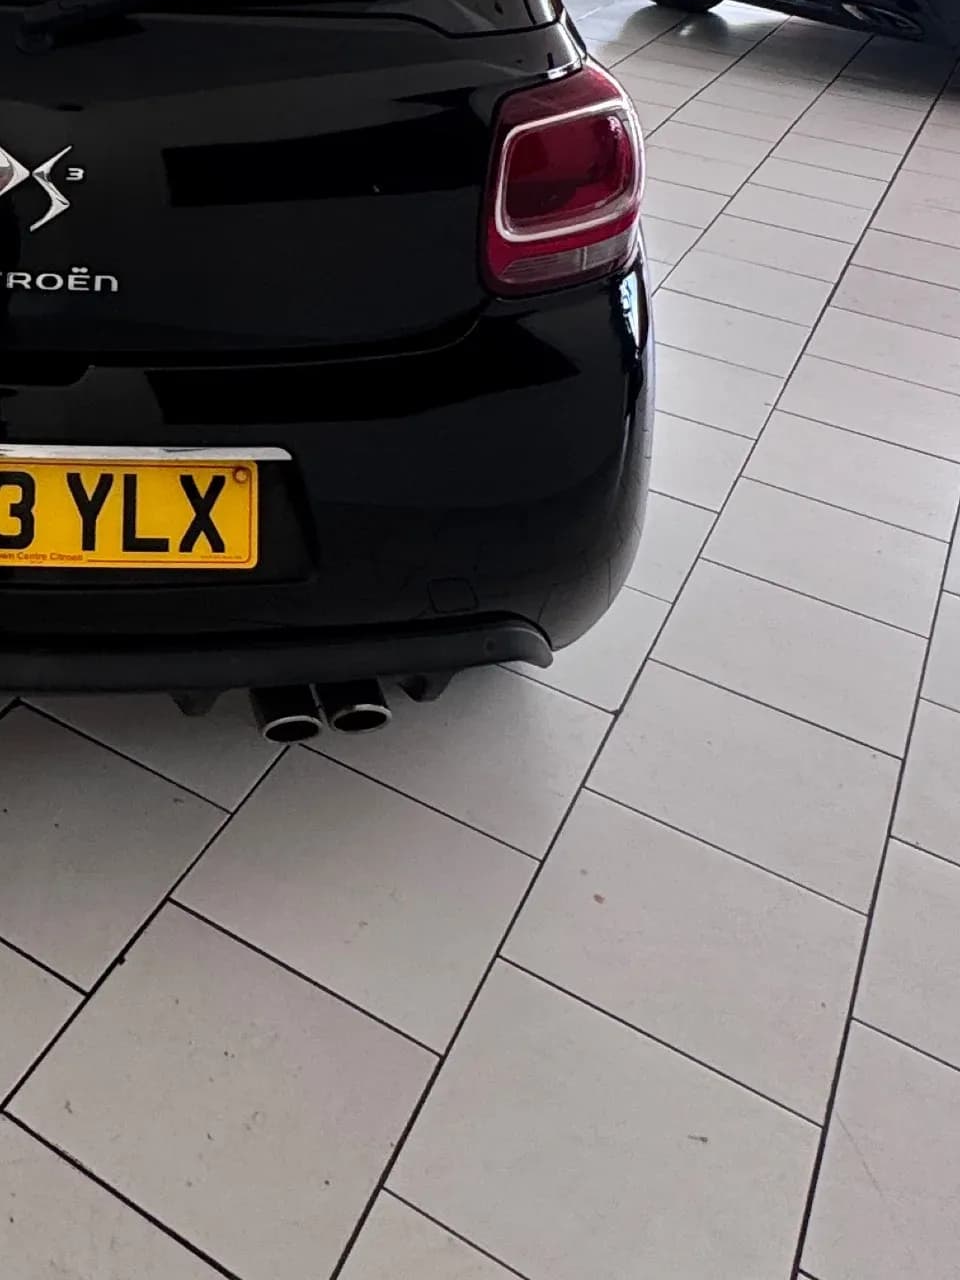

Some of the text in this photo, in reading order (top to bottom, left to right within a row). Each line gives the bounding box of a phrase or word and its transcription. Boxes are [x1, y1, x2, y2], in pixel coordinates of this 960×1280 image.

[65, 167, 85, 182] 3
[66, 471, 227, 554] YLX
[17, 552, 48, 561] Centre
